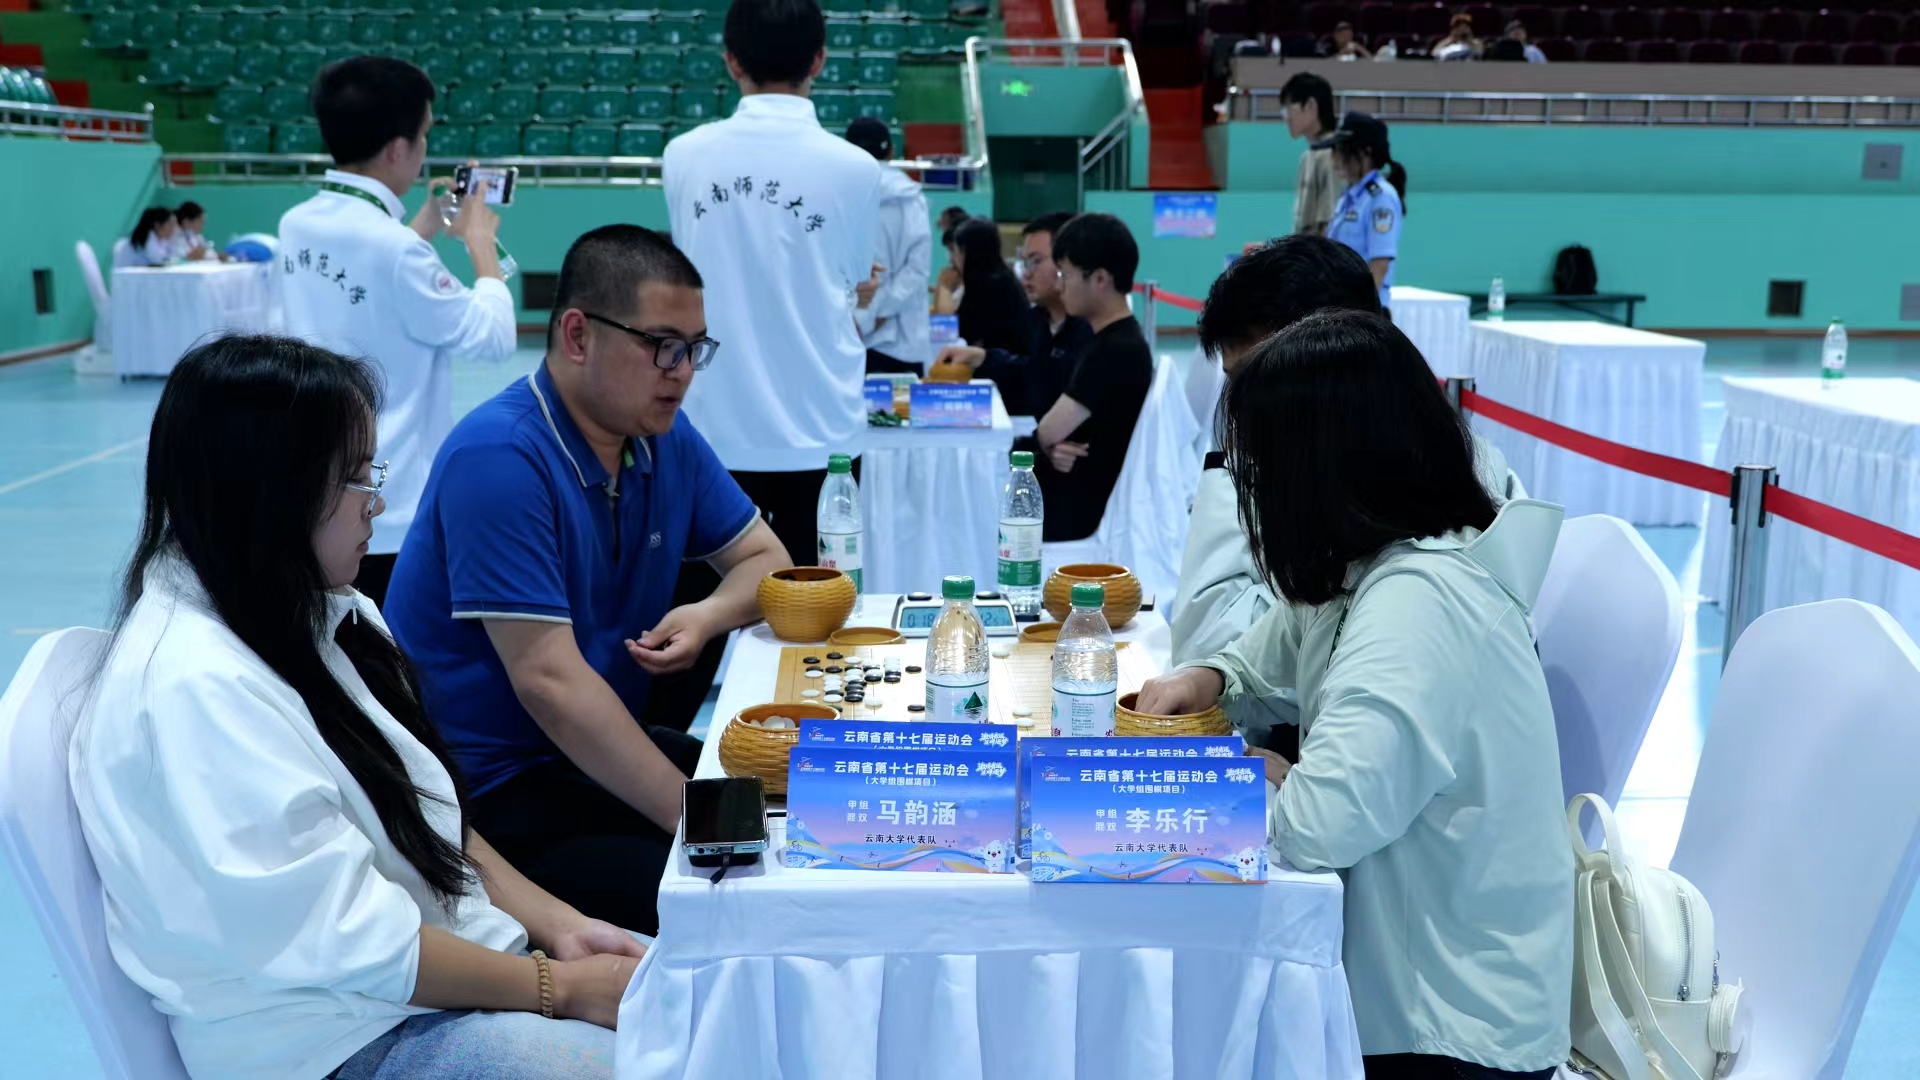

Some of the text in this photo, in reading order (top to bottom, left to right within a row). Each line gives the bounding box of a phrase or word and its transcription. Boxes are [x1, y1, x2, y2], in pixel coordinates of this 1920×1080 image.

[844, 731, 973, 745] 云南省第十七届运动会
[834, 761, 969, 776] 云南省第十七届运动会
[1080, 769, 1218, 783] 云南省第十七届运动会
[848, 800, 869, 810] 甲组
[876, 799, 957, 826] 马韵涵
[1096, 808, 1118, 819] 甲组
[1125, 807, 1209, 834] 李乐行
[865, 834, 937, 845] 云南大学代表队
[1114, 843, 1189, 853] 云南大学代表队
